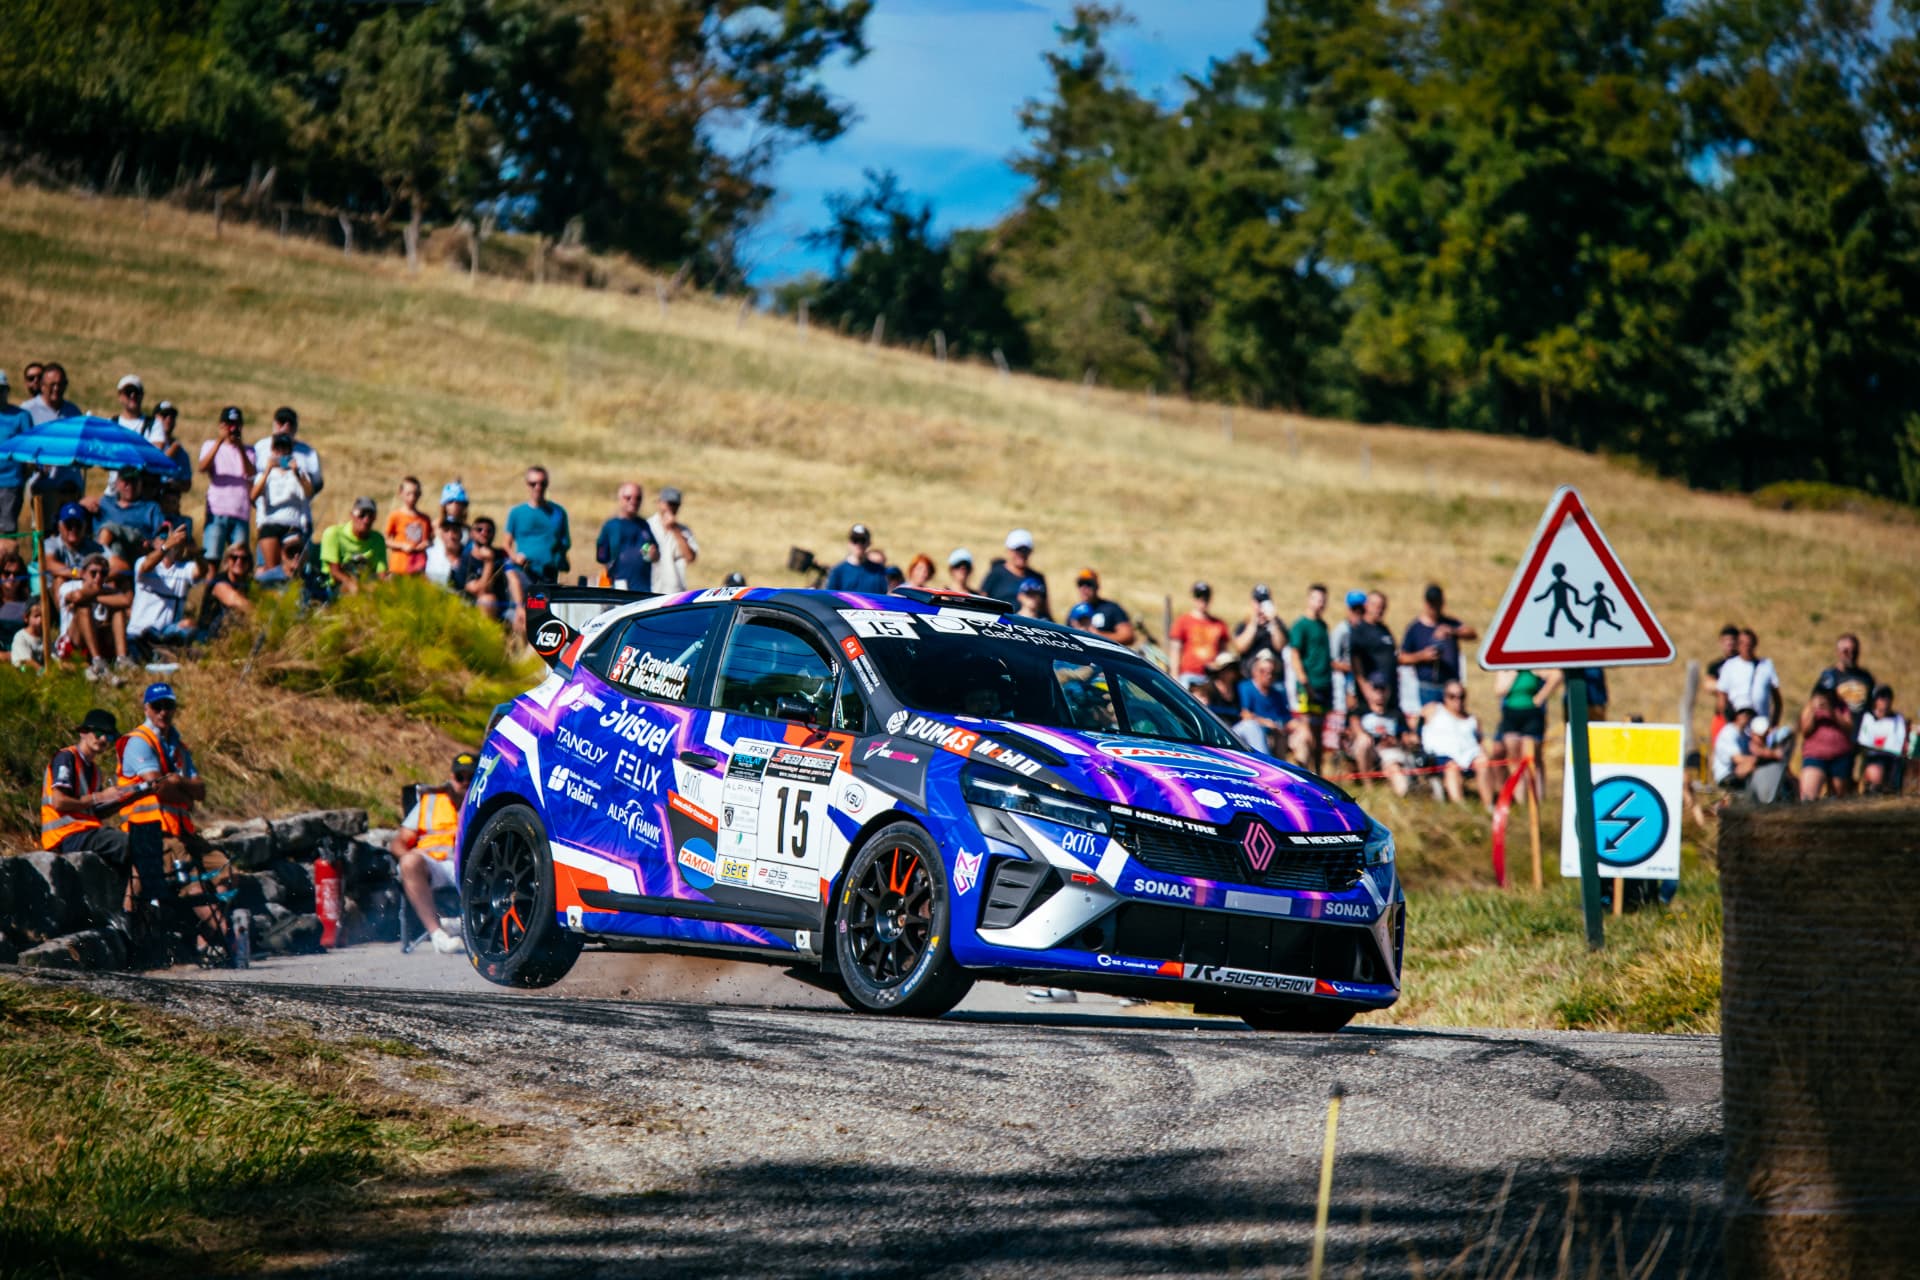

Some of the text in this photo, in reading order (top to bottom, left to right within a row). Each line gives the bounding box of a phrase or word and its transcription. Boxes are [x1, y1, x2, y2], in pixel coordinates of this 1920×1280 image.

[536, 631, 562, 648] KSU
[867, 621, 904, 636] 15
[965, 617, 1071, 641] oxygen
[981, 628, 1085, 652] data pilots
[626, 648, 691, 682] X. Craviolini
[619, 666, 630, 685] Y.
[629, 667, 685, 701] Micheloud
[556, 726, 609, 764] TANGUY
[906, 716, 977, 751] DUMAS
[614, 748, 662, 796] FELIX
[566, 779, 595, 806] Valair
[726, 783, 761, 794] ALPINE
[844, 790, 862, 809] KSU
[607, 803, 630, 826] ALPS
[635, 817, 662, 843] HAWK
[777, 786, 813, 858] 15
[1135, 811, 1219, 836] NEXEN TIRE
[679, 849, 716, 877] TAMOIL
[723, 857, 748, 878] isère
[1133, 878, 1192, 900] SONAX
[1324, 901, 1370, 918] SONAX
[1224, 971, 1314, 993] SUSPENSION
